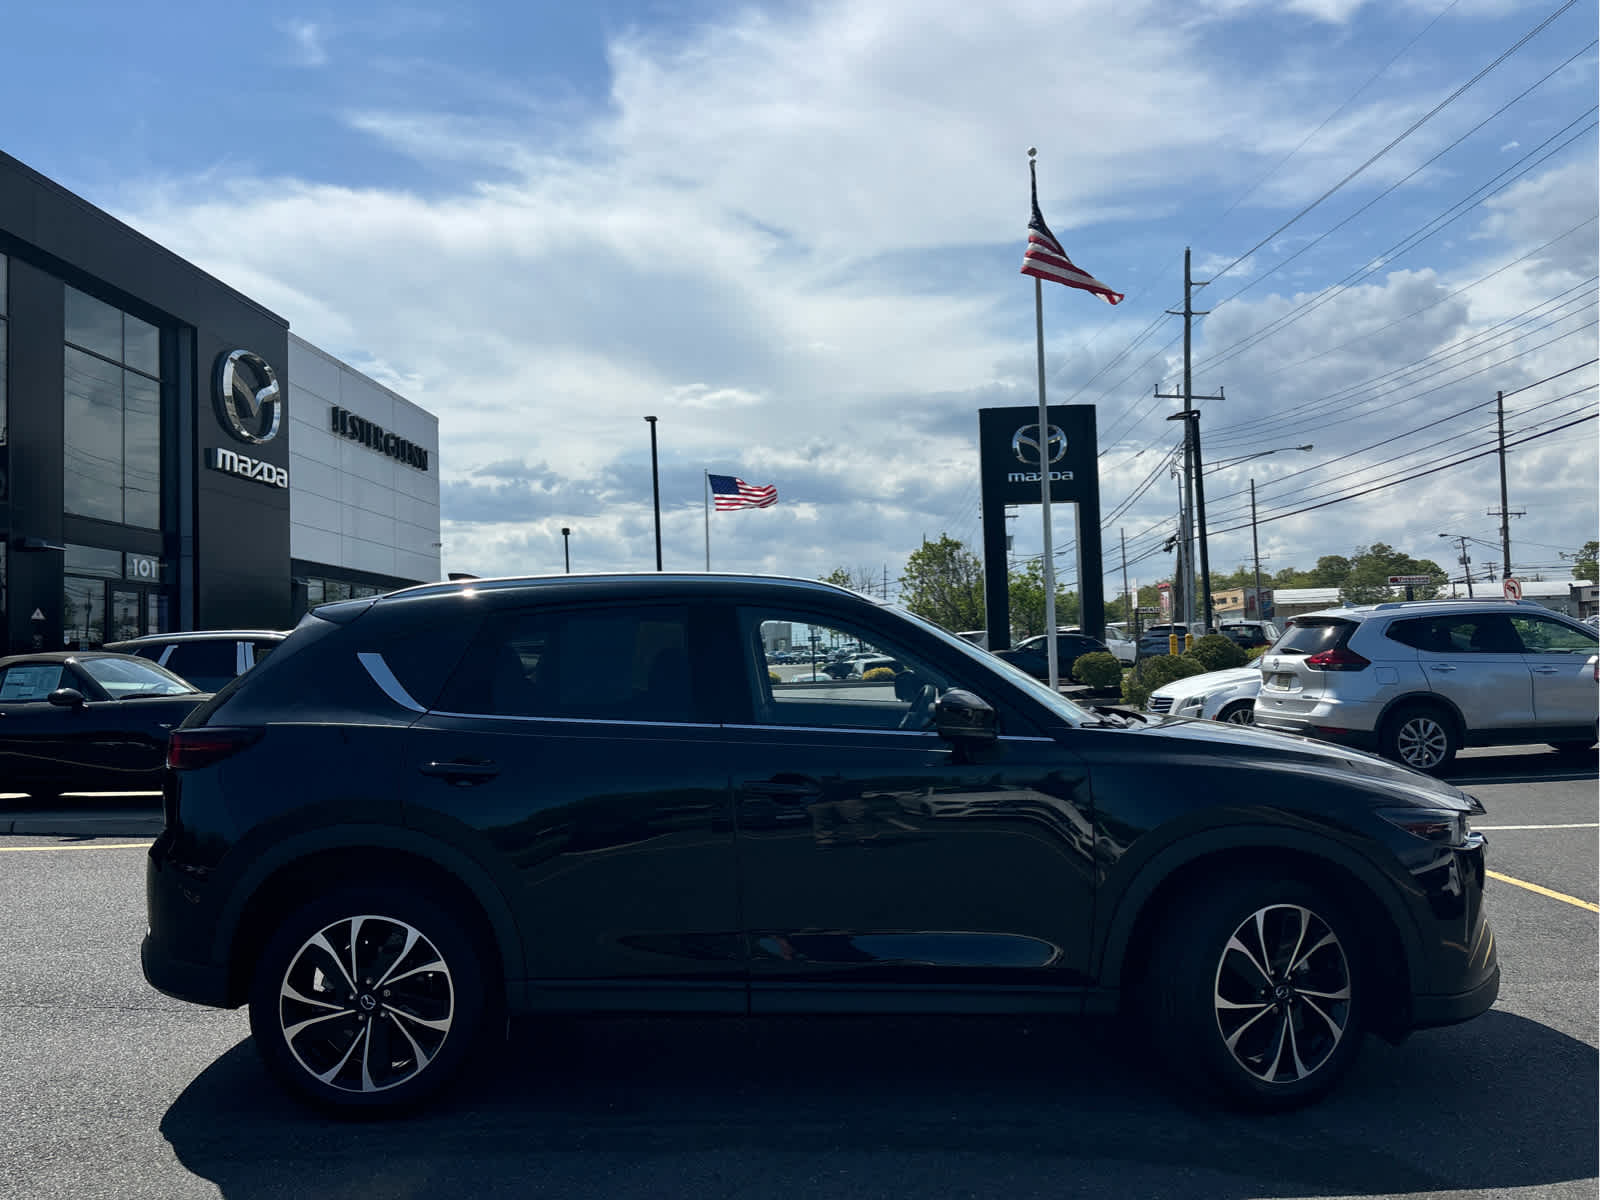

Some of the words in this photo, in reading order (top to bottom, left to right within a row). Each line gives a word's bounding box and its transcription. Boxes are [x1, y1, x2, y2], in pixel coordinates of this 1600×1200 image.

[217, 448, 288, 488] mazda
[1007, 470, 1074, 482] mada
[133, 558, 156, 578] 101
